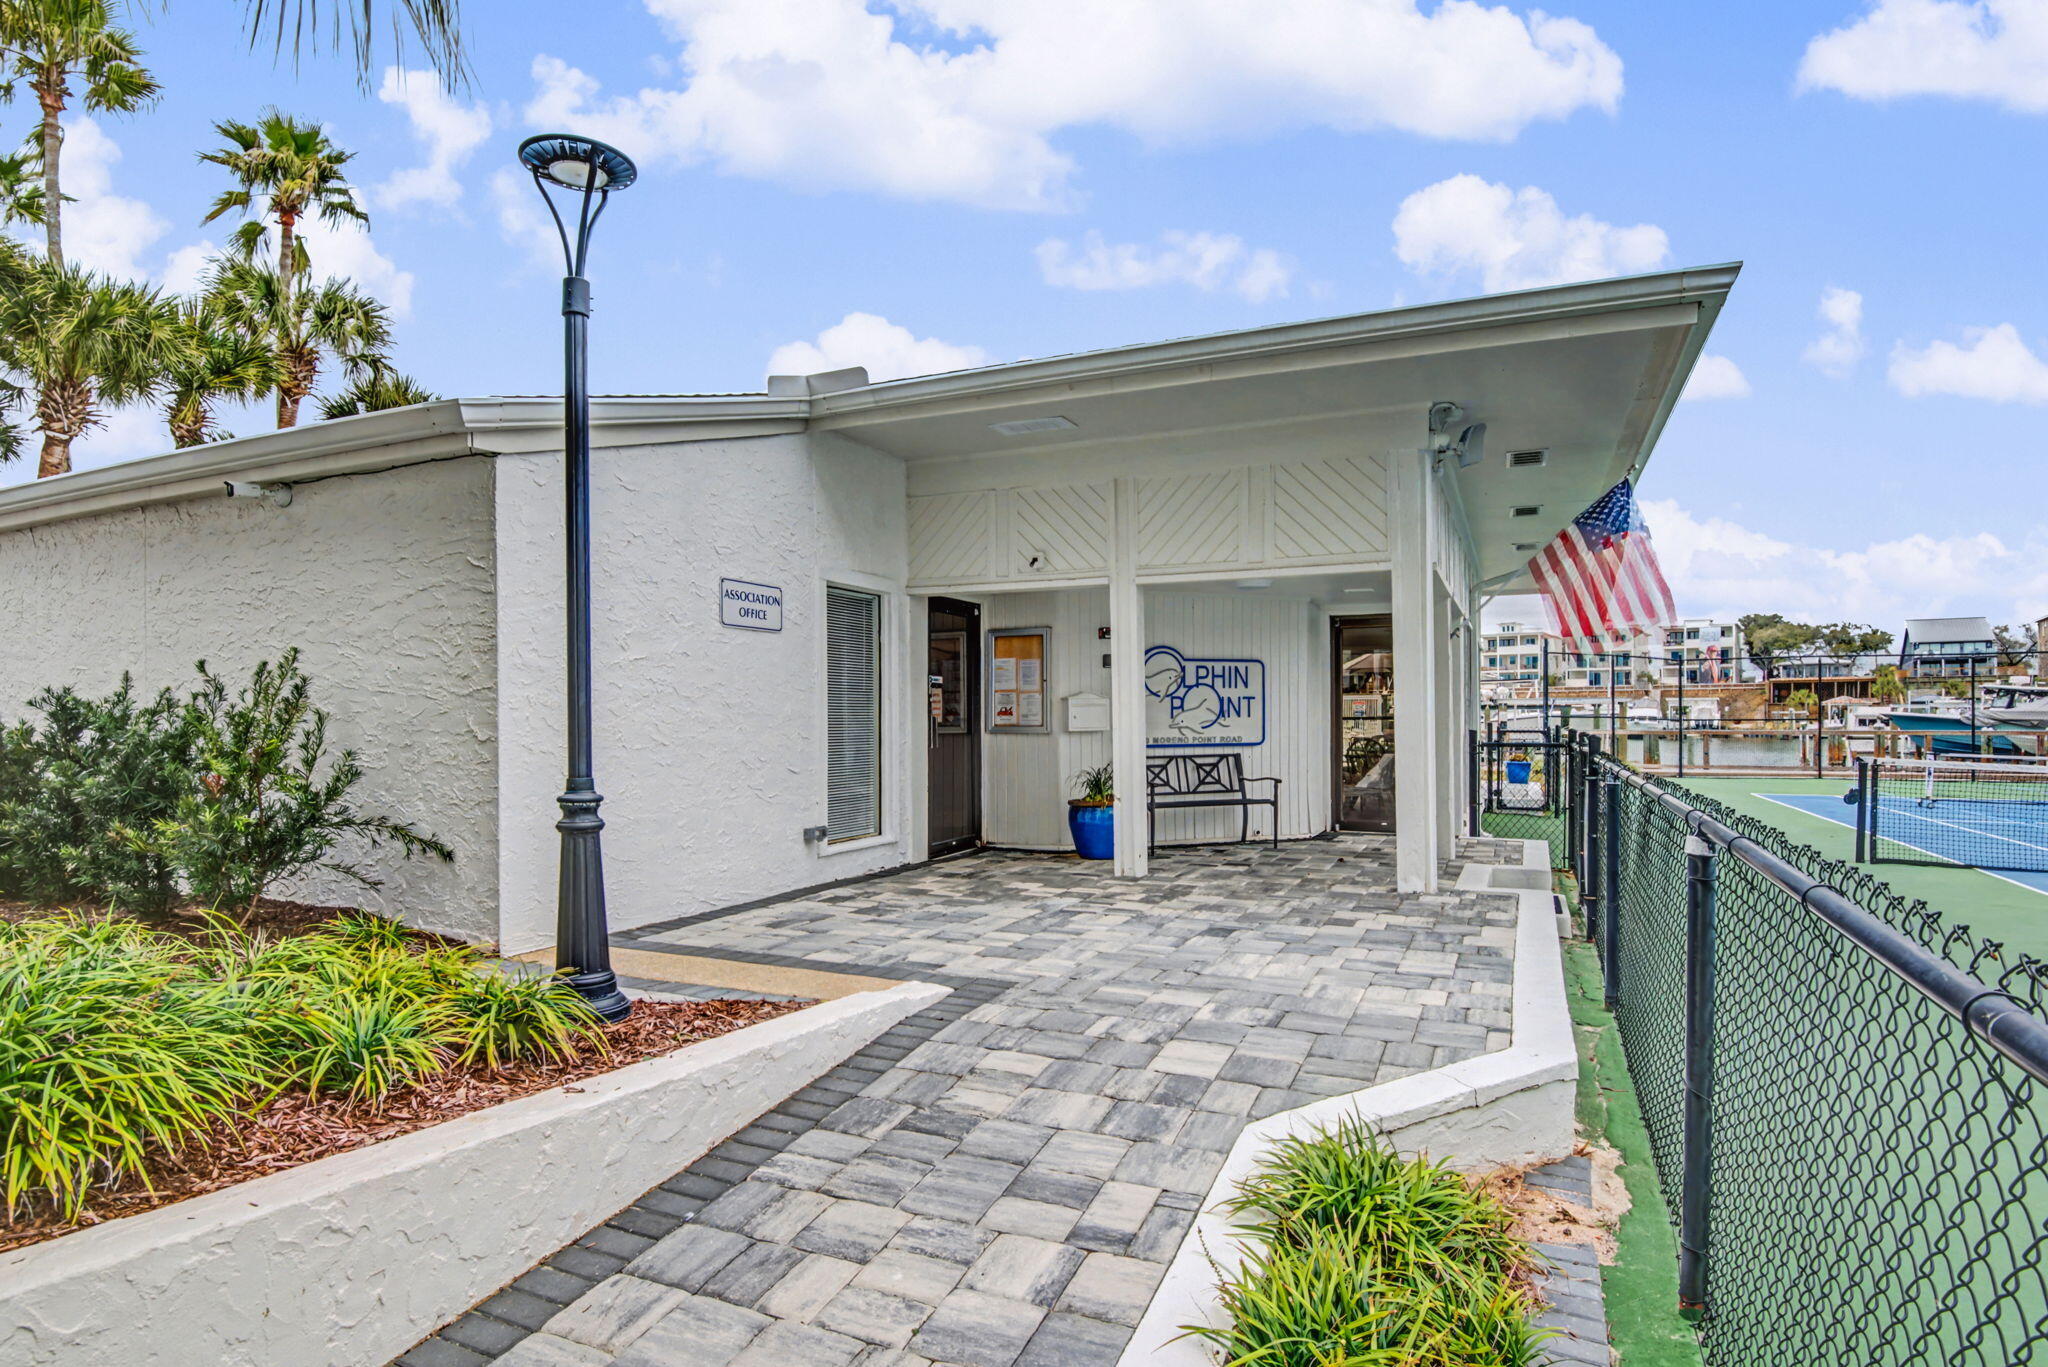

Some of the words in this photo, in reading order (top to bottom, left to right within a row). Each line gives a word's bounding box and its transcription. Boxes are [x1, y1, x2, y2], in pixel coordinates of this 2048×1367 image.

[724, 589, 781, 607] ASSOCIATION
[738, 606, 767, 620] OFFICE
[1144, 651, 1248, 698] OLPHIN
[1170, 683, 1256, 729] POINT
[1192, 736, 1216, 744] POINT
[1220, 735, 1243, 743] ROAD
